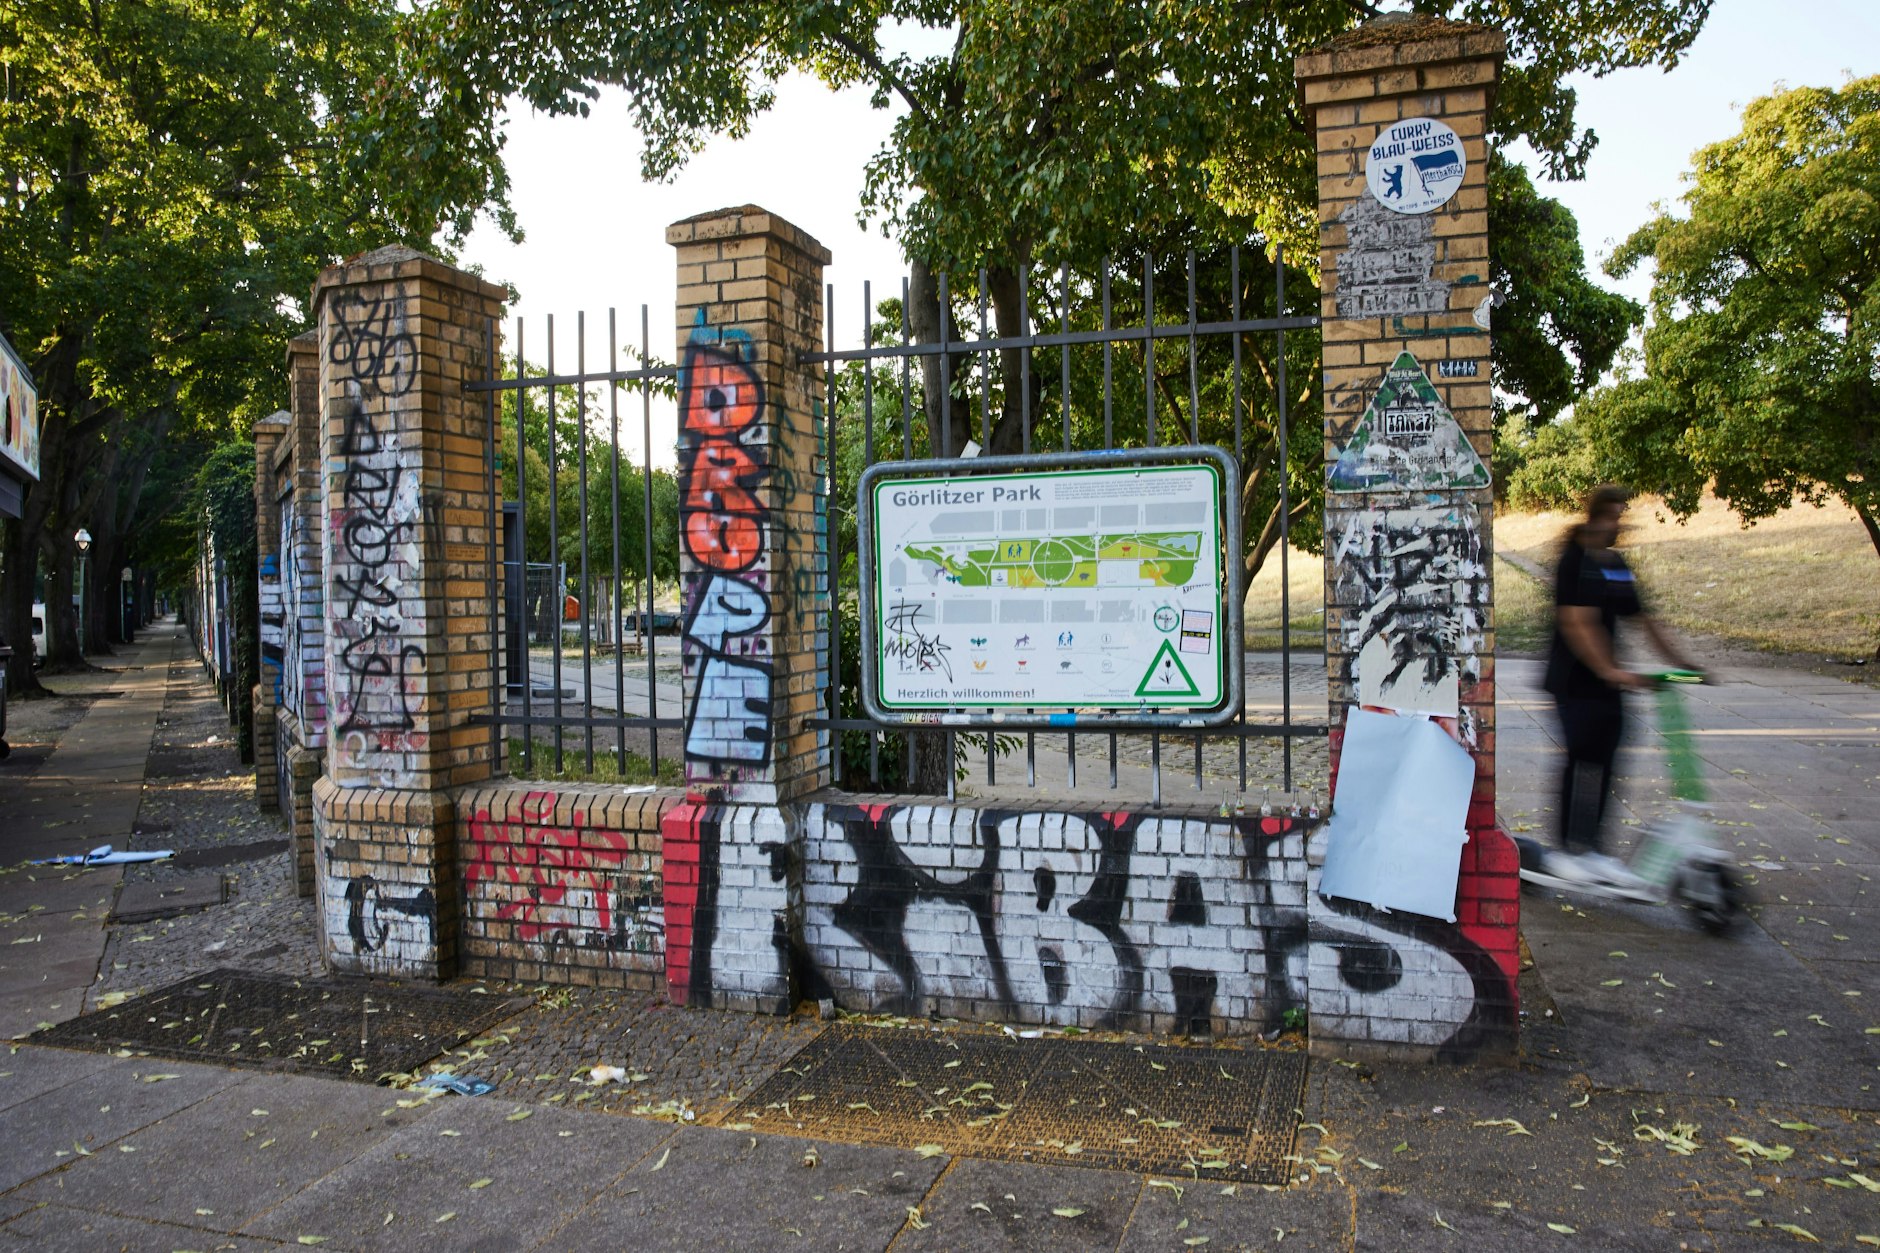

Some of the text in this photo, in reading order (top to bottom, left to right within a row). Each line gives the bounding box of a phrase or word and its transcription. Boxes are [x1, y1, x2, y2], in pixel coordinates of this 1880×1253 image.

[1391, 122, 1431, 141] CURRY
[1373, 133, 1454, 160] BLAU-WEISS
[892, 487, 985, 507] Görlitzer
[992, 485, 1042, 503] Park
[898, 688, 1036, 699] Herzlich willkommen!
[921, 713, 941, 724] BIEN
